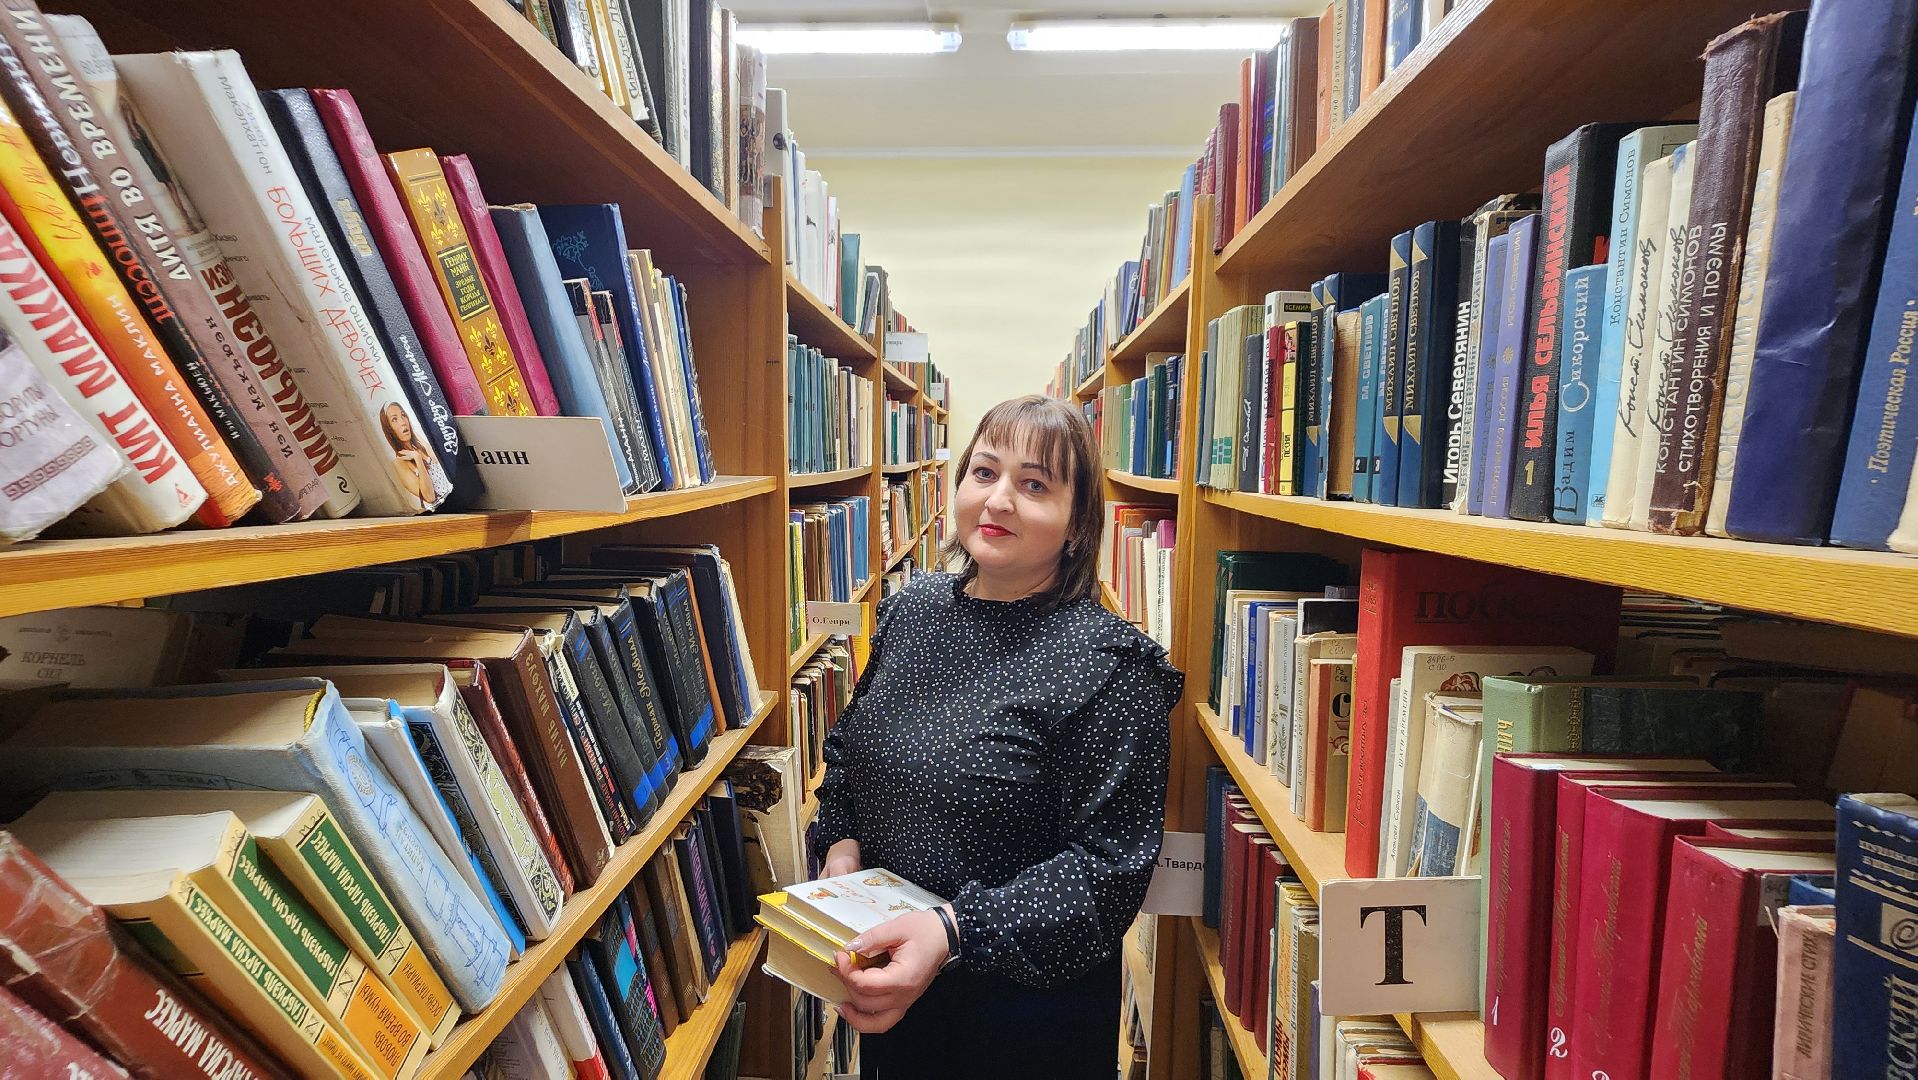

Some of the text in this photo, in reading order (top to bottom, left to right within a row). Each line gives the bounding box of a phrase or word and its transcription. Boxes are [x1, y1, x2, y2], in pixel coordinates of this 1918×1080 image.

[9, 6, 192, 282] ДИТЯ ВО ВРЕМЕНИ
[200, 260, 235, 291] ИЭН
[444, 252, 469, 268] ГЕНРИХ
[450, 262, 470, 277] МАНН
[1608, 148, 1637, 327] Константин Симонов
[266, 186, 336, 297] БОЛЬШИХ
[320, 308, 388, 400] ДЕВОЧЕК
[303, 214, 354, 303] маленькие
[346, 302, 384, 363] ошибки
[1524, 164, 1572, 449] ИЛЬЯ СЕЛЬВИНСКИЙ
[1627, 237, 1657, 350] Симонов
[0, 215, 178, 484] КИТ МАККА
[199, 314, 268, 411] Макьюэн
[215, 284, 340, 477] МАКЬЮЭН
[1304, 315, 1320, 421] МИХАИЛ СВЕТЛОВ
[1361, 314, 1373, 399] М. СВЕТЛОВ
[1385, 276, 1400, 410] МИХАИЛ СВЕТЛОВ
[1404, 269, 1420, 408] МИХАИЛ СВЕТЛОВ
[1656, 224, 1703, 473] КОНСТАНТИН СИМОНОВ
[1679, 221, 1728, 473] СТИХОТВОРЕНИЯ И ПОЭМЫ
[107, 293, 238, 487] ДЖУЛИАННА МАКЛИН
[1443, 301, 1471, 483] Игорь Северянин
[1554, 275, 1592, 516] Вадим Сикорский
[1866, 312, 1918, 473] Поэтическая Россия
[264, 420, 295, 458] Иэн
[1355, 459, 1361, 471] 2
[1525, 460, 1536, 485] 1
[520, 651, 553, 714] МАХФУЗ
[623, 634, 651, 698] Мелвилл
[543, 718, 571, 767] НАГИБ
[234, 853, 276, 900] МАРКЕС
[267, 893, 305, 934] ГАРСИА
[307, 830, 396, 944] ГАБРИЭЛЬ ГАРСИА МАРКЕС
[188, 894, 306, 1021] ГАБРИЭЛЬ ГАРСИА МАРКЕС
[295, 926, 341, 977] ГАБРИЭЛЬ
[398, 960, 444, 1017] ОСЕНЬ ПАТРИАРХА
[1360, 905, 1427, 986] Т
[144, 988, 217, 1062] МАРКЕС
[355, 982, 413, 1047] ВО ВРЕМЯ ЧУМЫ
[369, 1028, 403, 1067] ЛЮБОВЬ
[1549, 1027, 1568, 1058] 2
[1790, 974, 1823, 1058] ЛИРИЧЕСКИЕ
